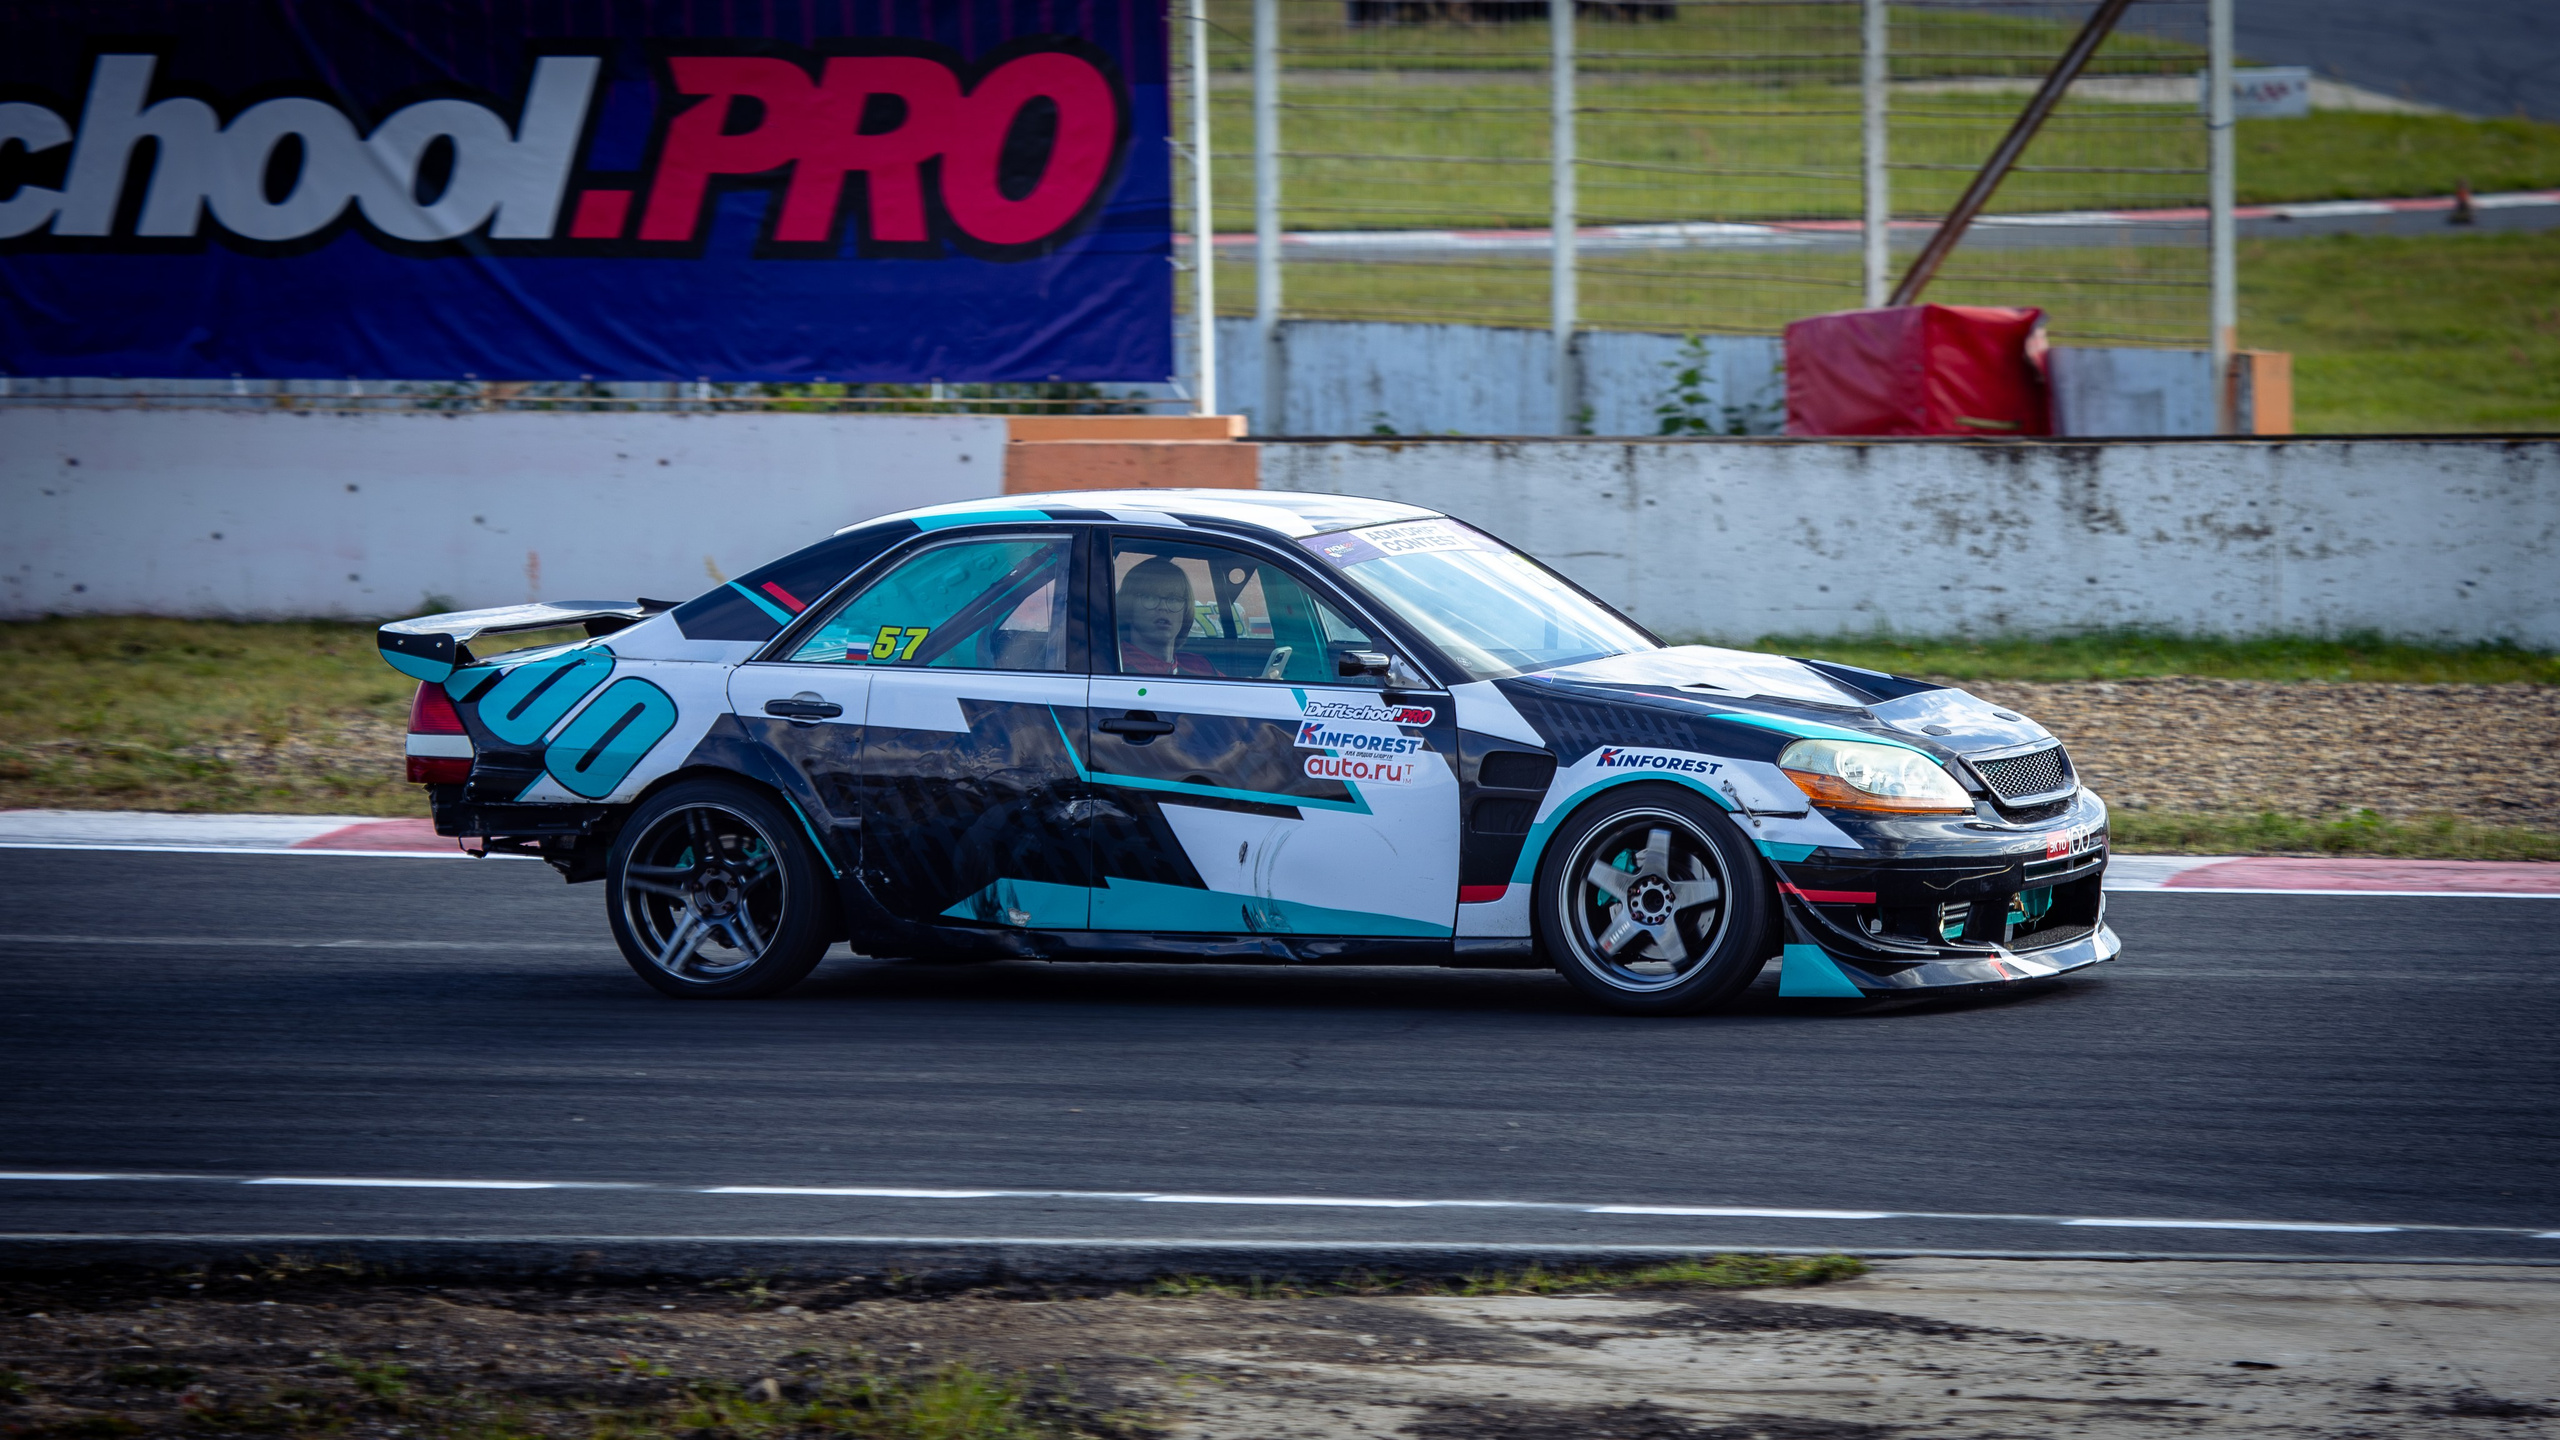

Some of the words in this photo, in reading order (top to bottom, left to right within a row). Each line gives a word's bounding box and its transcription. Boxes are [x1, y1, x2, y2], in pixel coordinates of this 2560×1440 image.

[1365, 528, 1405, 541] ADM
[1381, 535, 1464, 551] CONTEST
[870, 625, 931, 661] 57
[1304, 702, 1433, 724] Driftschool.PRO
[1298, 722, 1421, 754] KINFOREST
[1307, 758, 1402, 782] auto.ru
[1596, 748, 1723, 775] KINFOREST
[2066, 824, 2090, 856] 100
